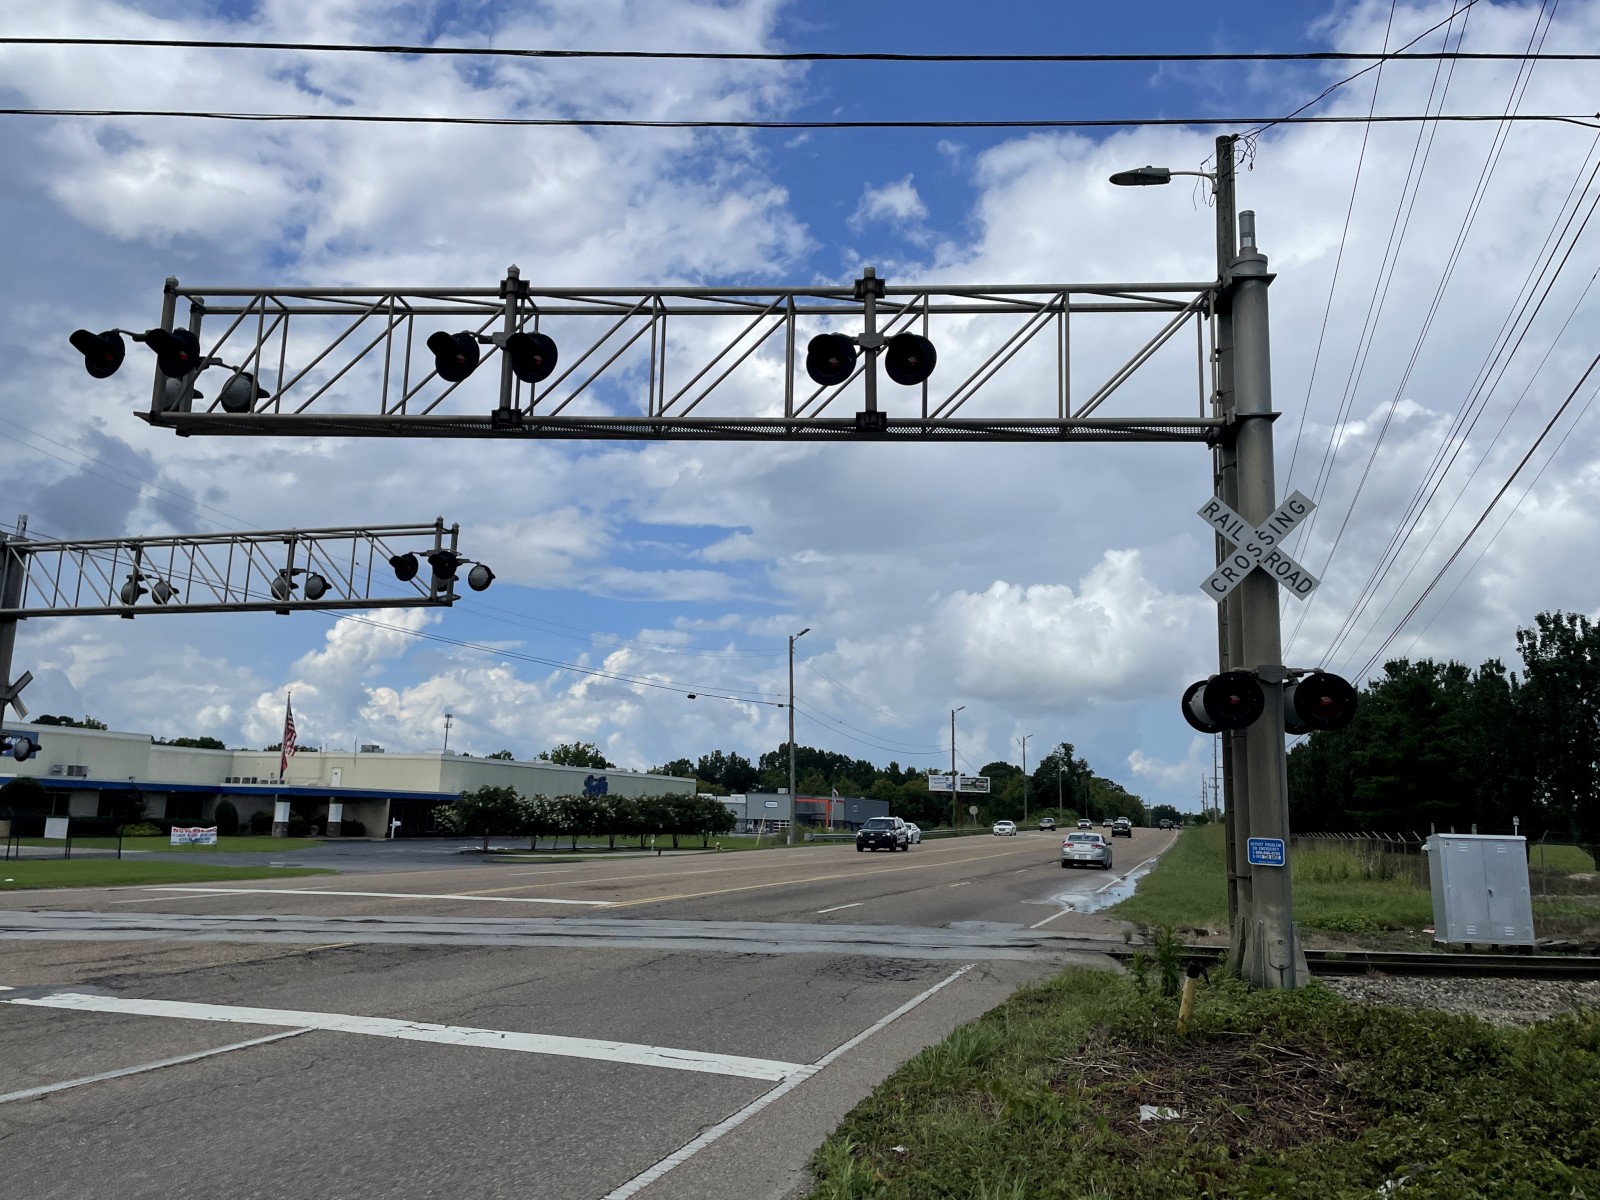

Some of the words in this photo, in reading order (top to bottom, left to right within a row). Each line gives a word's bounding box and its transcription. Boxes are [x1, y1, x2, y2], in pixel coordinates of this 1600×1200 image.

[1203, 501, 1244, 542] RAIL
[1264, 551, 1313, 594] ROAD
[1210, 500, 1306, 593] CROSSING
